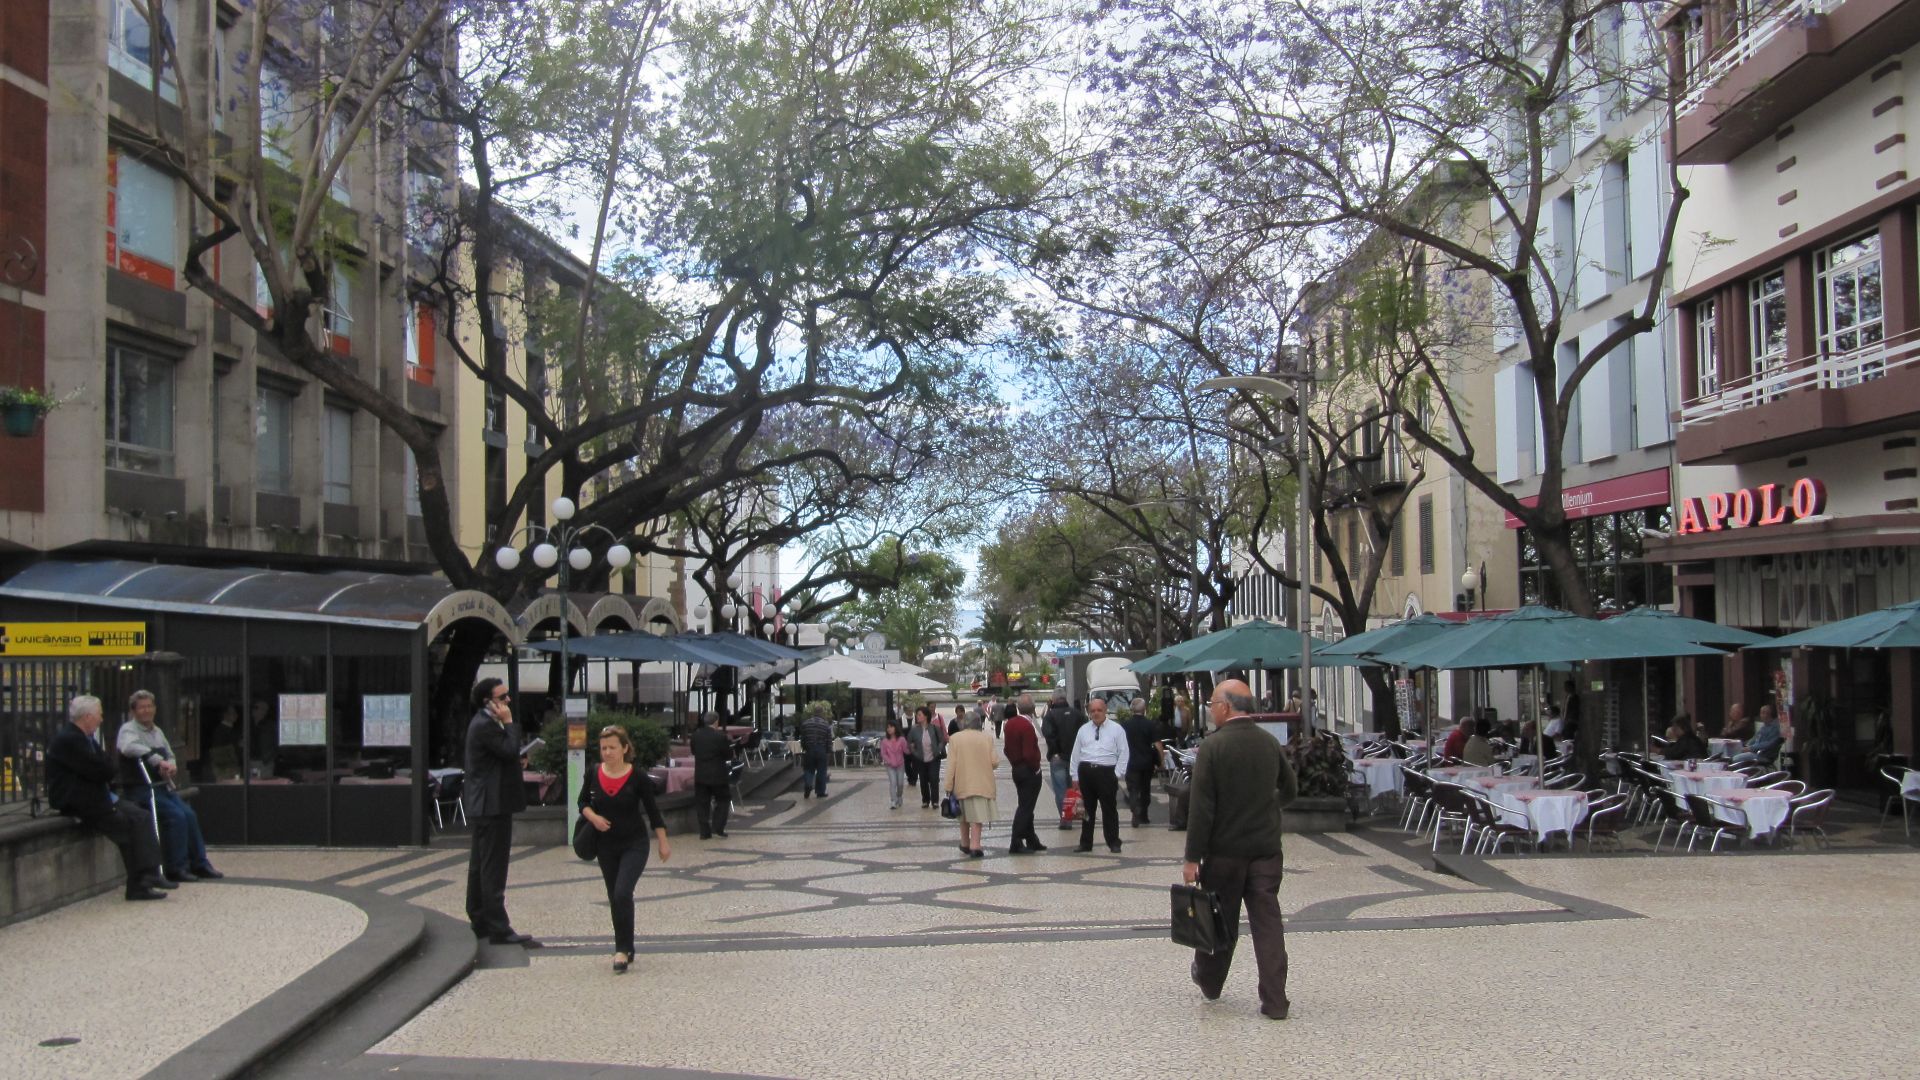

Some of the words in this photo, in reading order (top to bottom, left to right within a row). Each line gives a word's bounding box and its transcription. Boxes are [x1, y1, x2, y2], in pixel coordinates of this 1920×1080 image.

[1678, 478, 1820, 535] APOLO
[88, 631, 134, 639] WESTERN
[103, 638, 134, 646] UNION
